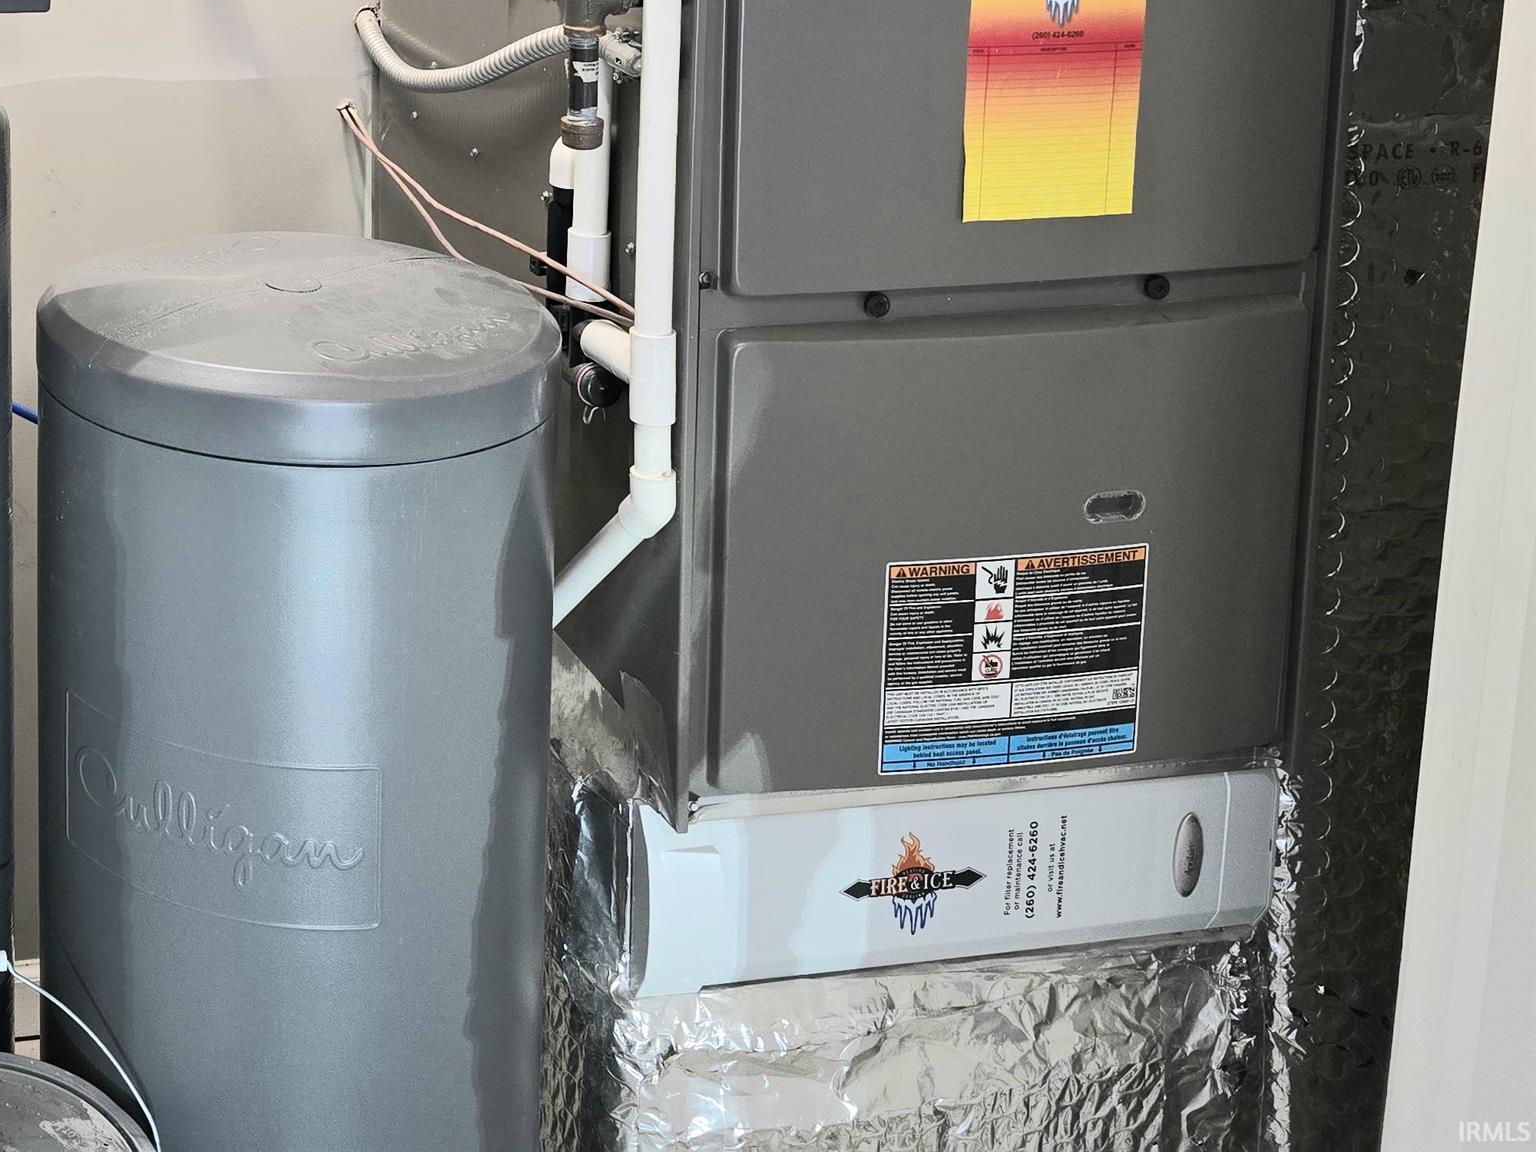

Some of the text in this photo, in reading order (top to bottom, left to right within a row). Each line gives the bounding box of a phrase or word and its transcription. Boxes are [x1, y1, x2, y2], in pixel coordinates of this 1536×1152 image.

[1037, 550, 1138, 569] AVERTISSEMENT
[909, 564, 970, 577] WARNING
[76, 746, 364, 889] Culligan
[1006, 829, 1014, 879] replacement
[1049, 843, 1055, 851] at
[1050, 853, 1054, 862] us
[1014, 849, 1022, 899] maintenance
[1025, 821, 1038, 918] (260) 424-6260
[870, 871, 953, 896] FIRE & ICE
[1048, 884, 1053, 892] or
[1014, 901, 1019, 910] or
